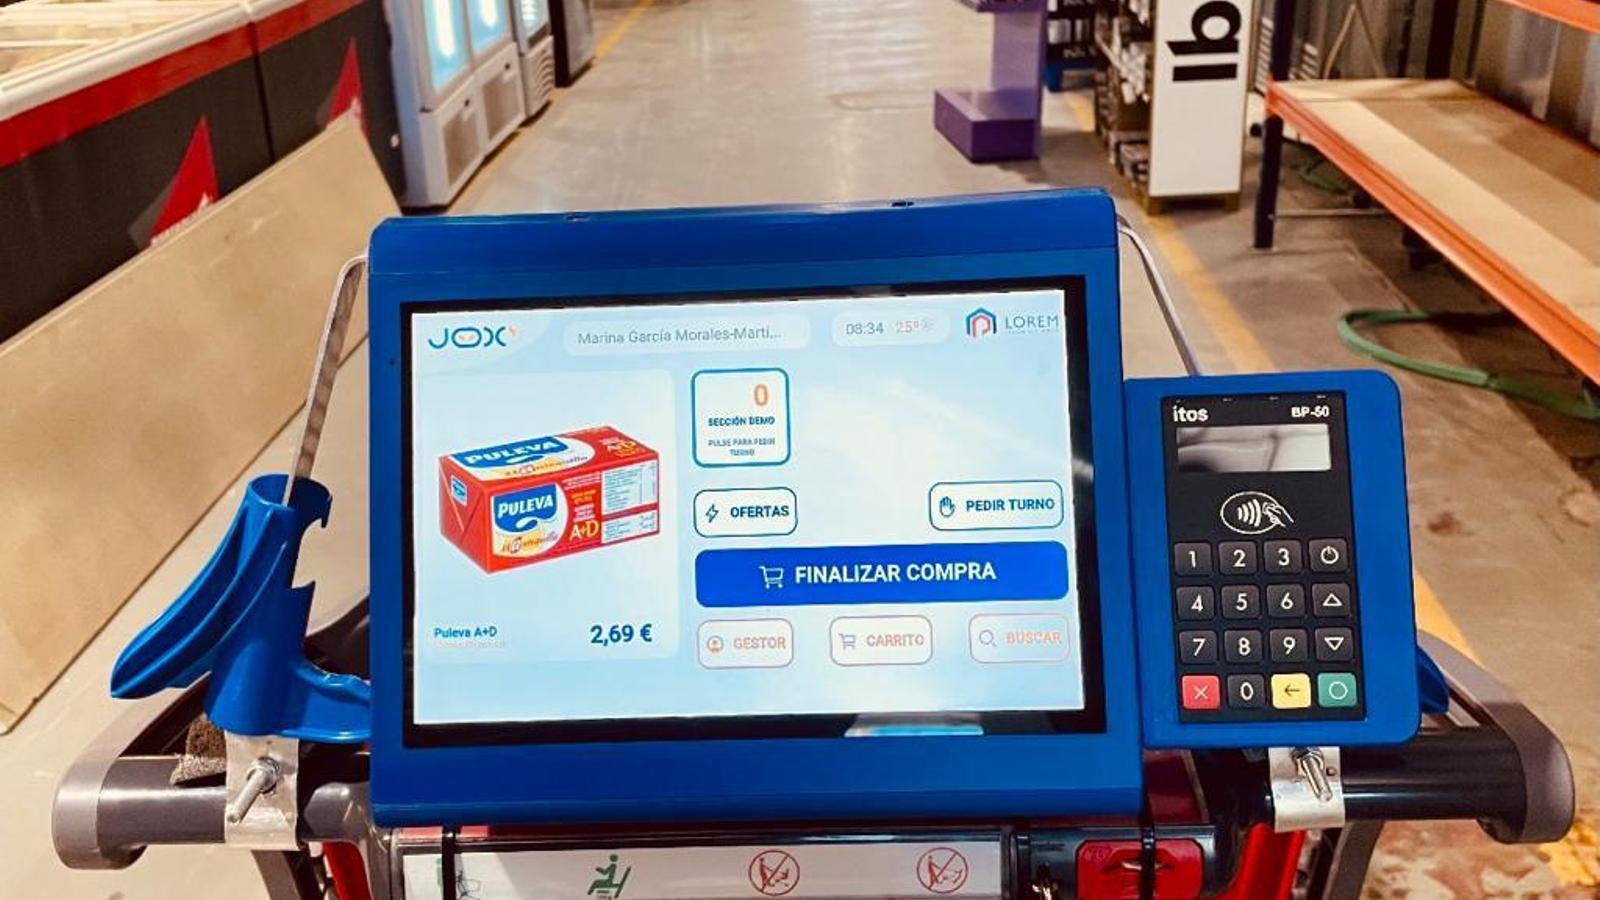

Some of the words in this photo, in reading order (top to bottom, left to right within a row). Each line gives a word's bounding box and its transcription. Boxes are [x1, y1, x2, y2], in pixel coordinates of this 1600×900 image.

[846, 322, 885, 336] 08:34
[1005, 315, 1059, 330] LOREM
[578, 331, 625, 346] Marina
[754, 383, 769, 406] 0
[708, 416, 747, 427] SECCIÓN
[749, 415, 775, 425] DEMO
[1291, 406, 1330, 419] BP-50
[464, 442, 561, 463] PULEVA
[498, 495, 554, 518] PULEVA
[730, 504, 790, 519] OFERTAS
[966, 498, 1006, 512] PEDIR
[1009, 497, 1055, 511] TURNO
[569, 520, 600, 541] A+D
[1188, 551, 1196, 568] 1
[1233, 549, 1246, 567] 2
[1278, 548, 1290, 566] 3
[795, 565, 901, 584] FINALIZAR
[906, 562, 997, 581] COMPRA
[1191, 594, 1203, 612] 4
[1236, 593, 1248, 611] 5
[1280, 592, 1293, 609] 6
[434, 627, 471, 639] Puleva
[474, 625, 498, 638] A+D
[590, 624, 634, 647] 2,69
[640, 623, 652, 642] €
[866, 632, 925, 648] CARRITO
[1006, 630, 1061, 645] BUSCAR
[733, 635, 786, 650] GESTOR
[1192, 638, 1205, 656] 7
[1238, 637, 1251, 656] 8
[1283, 636, 1296, 655] 9
[1240, 682, 1254, 700] 0
